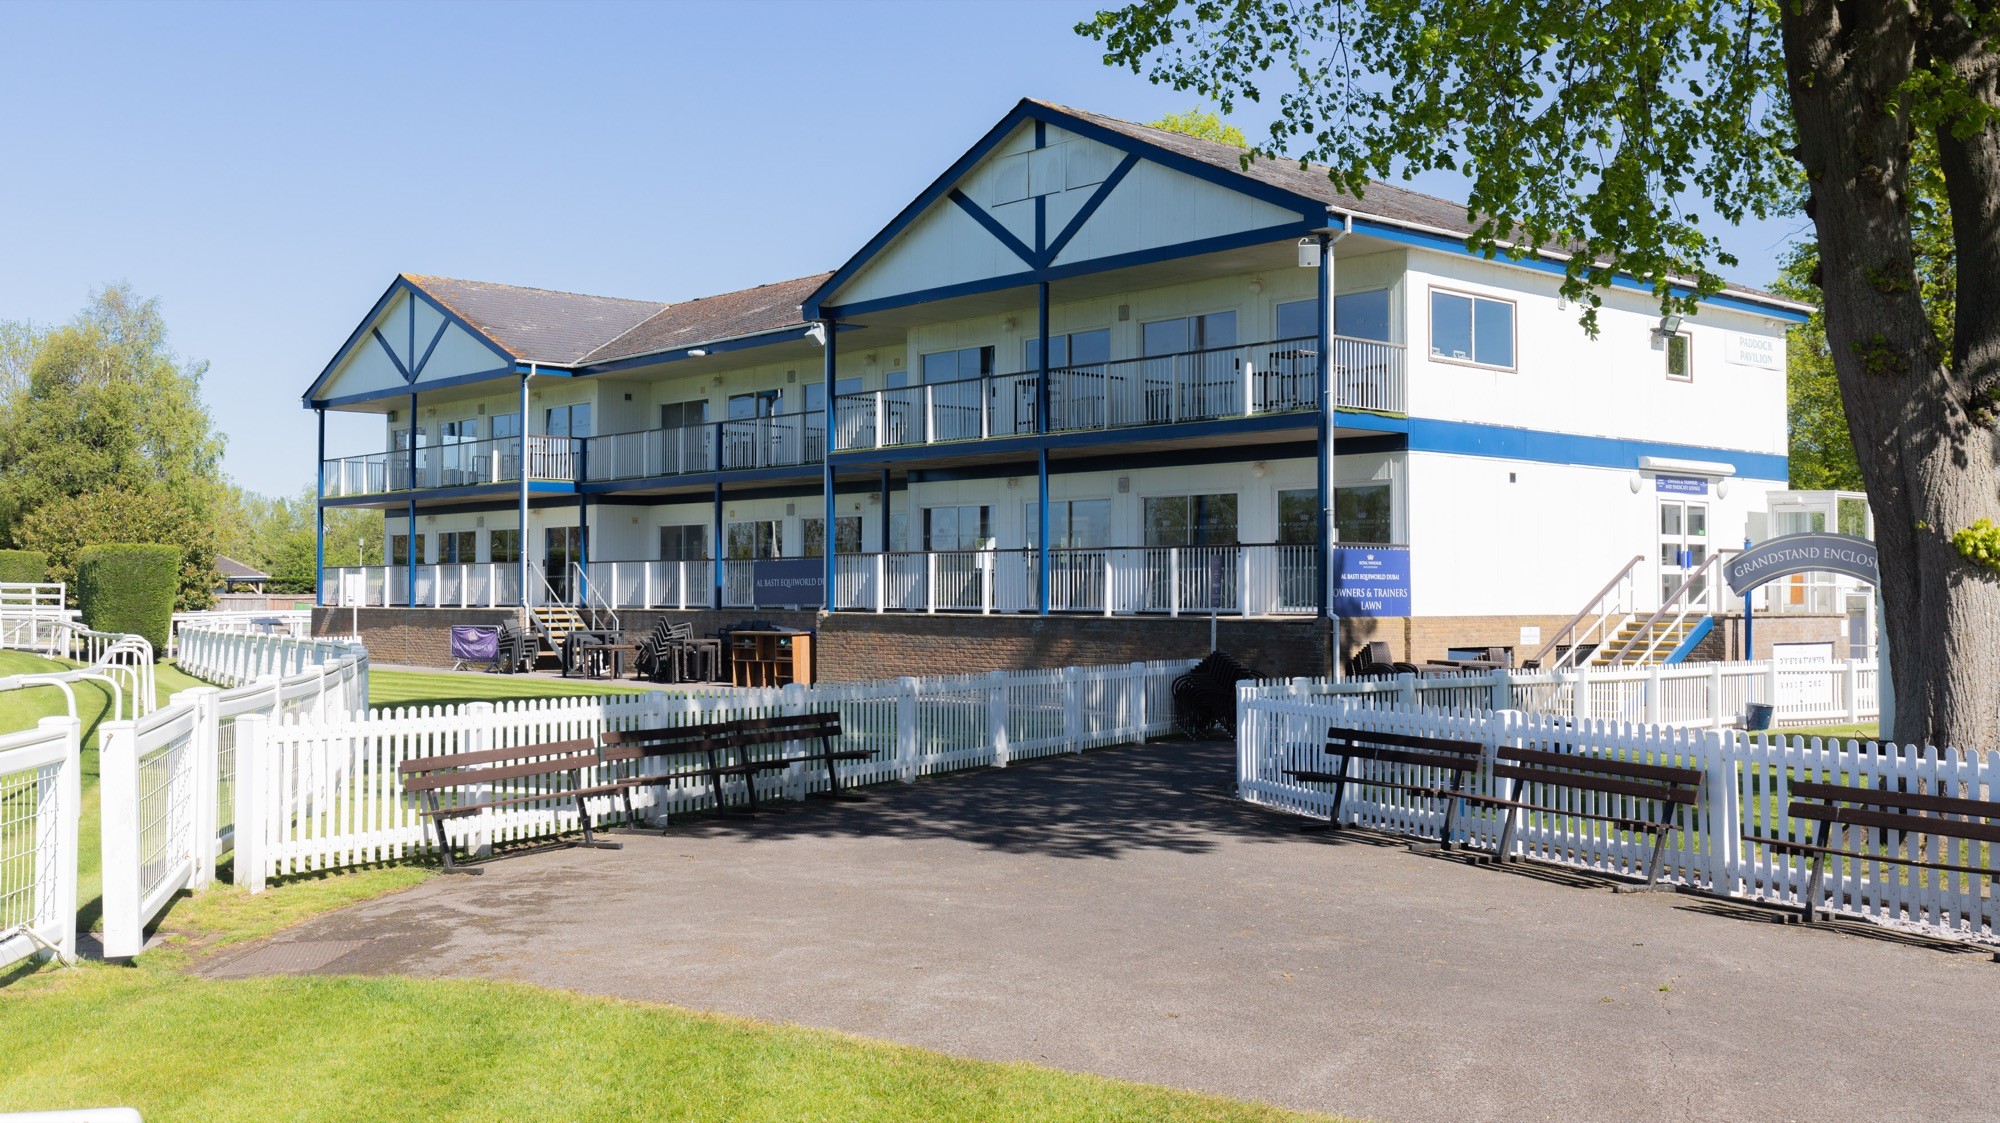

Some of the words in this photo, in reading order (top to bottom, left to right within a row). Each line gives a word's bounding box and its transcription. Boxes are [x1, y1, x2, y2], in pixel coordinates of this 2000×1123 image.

[1739, 336, 1773, 351] PADDOCK
[1740, 350, 1773, 365] PAVILION
[1734, 547, 1820, 578] GRANDSTAND
[756, 579, 763, 587] AL
[764, 578, 780, 587] BASTI
[781, 577, 816, 588] EQUIWORLD
[1360, 573, 1386, 581] EQUIWORLD
[1333, 588, 1365, 598] OWNERS
[1366, 588, 1373, 598] &
[1373, 588, 1408, 598] TRAINERS
[1360, 601, 1382, 611] LAWN
